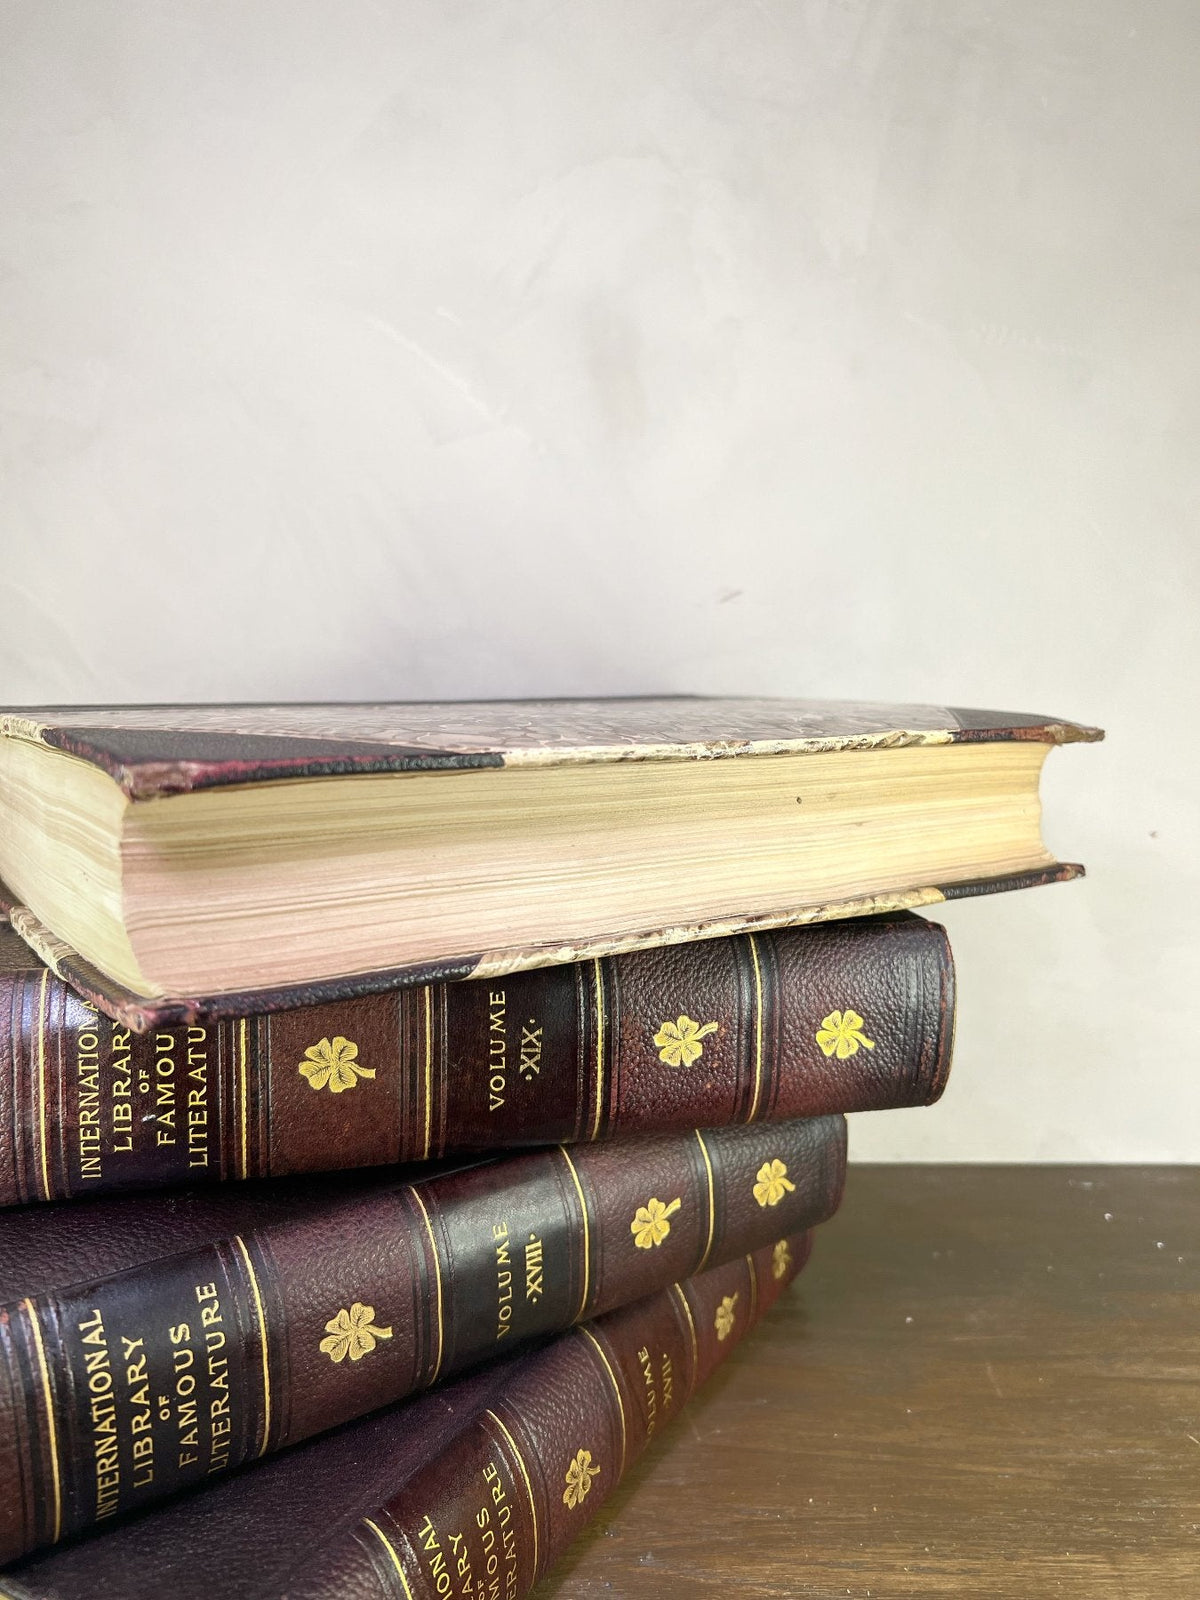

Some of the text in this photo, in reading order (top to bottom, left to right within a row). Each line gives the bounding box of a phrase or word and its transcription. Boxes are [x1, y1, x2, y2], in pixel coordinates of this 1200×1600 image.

[139, 1069, 149, 1093] OF
[156, 1034, 176, 1146] FAMOU
[188, 1026, 208, 1167] LITERATU
[489, 990, 506, 1112] VOLUME
[492, 1221, 513, 1340] VOLUME
[79, 1309, 120, 1521] INTERNATIONAL
[121, 1336, 154, 1488] LIBRARY
[158, 1395, 170, 1421] OF
[169, 1322, 198, 1468] FAMOUS
[195, 1282, 231, 1474] LITERATURE
[448, 1532, 474, 1600] ARY
